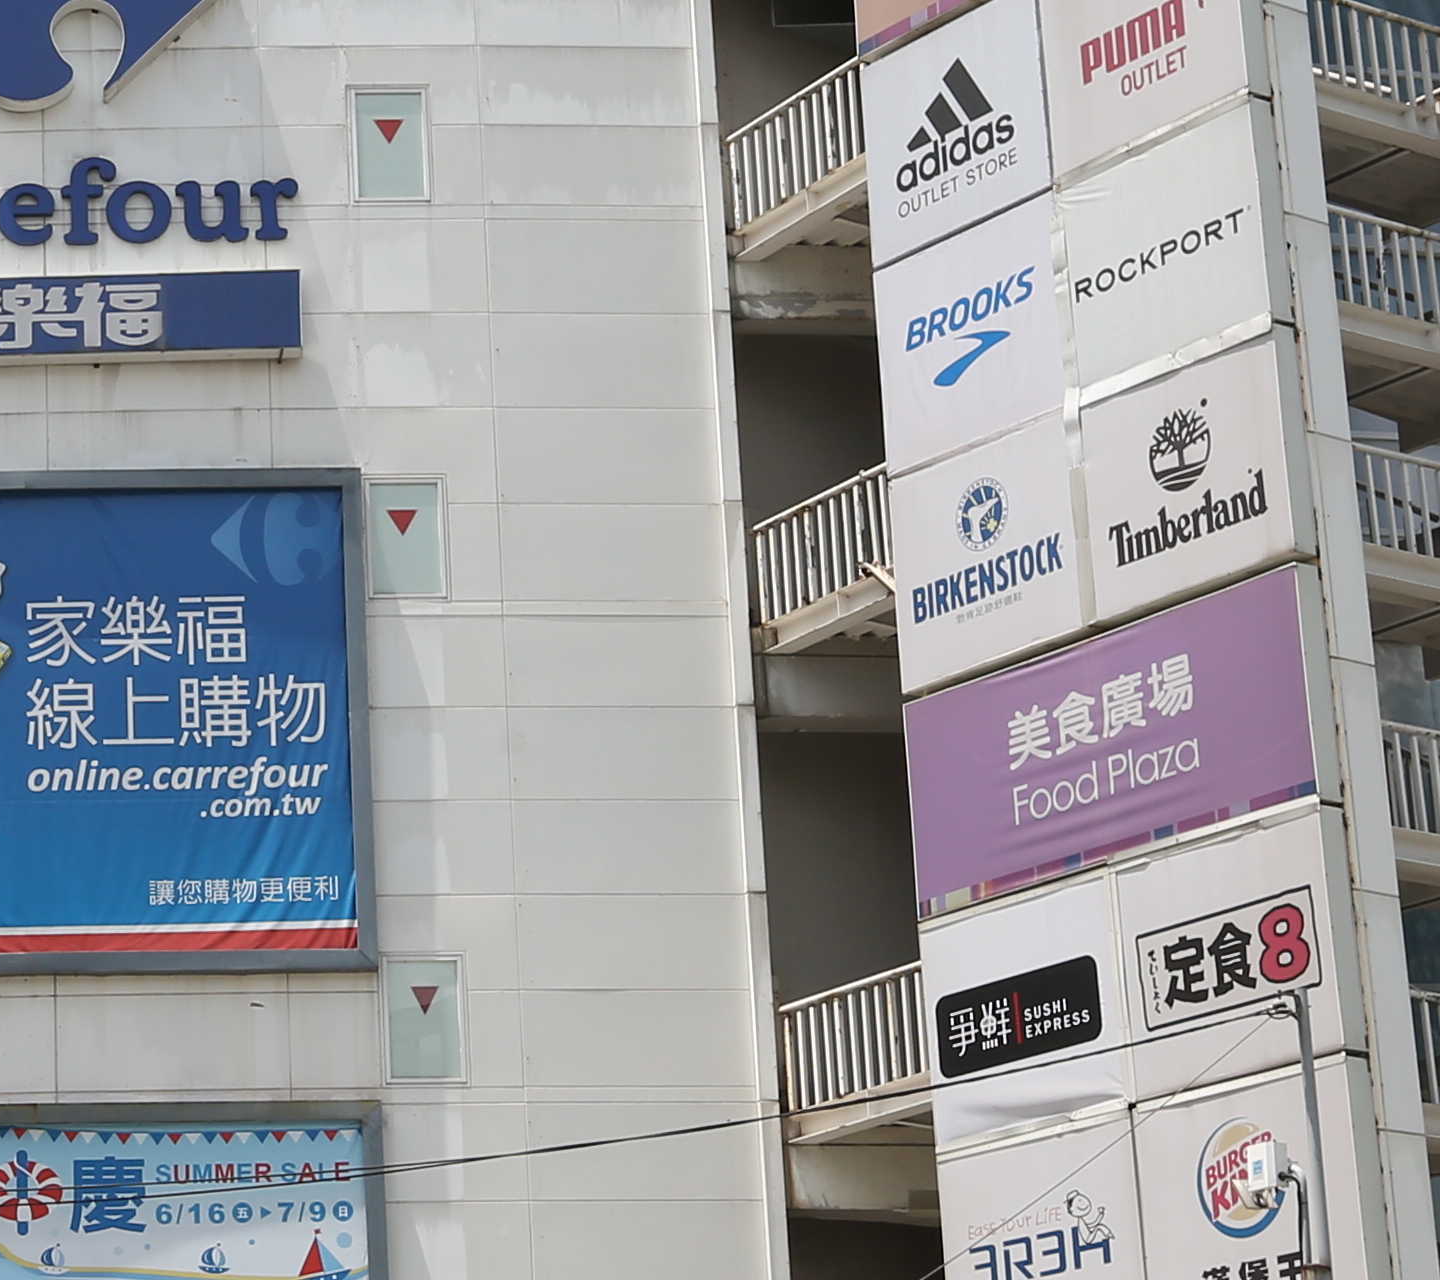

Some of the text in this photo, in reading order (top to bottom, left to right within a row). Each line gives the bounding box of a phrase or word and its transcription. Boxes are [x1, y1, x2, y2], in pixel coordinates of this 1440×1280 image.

[1120, 45, 1187, 97] OUTLET
[896, 113, 1016, 193] adidas
[898, 147, 1019, 219] OUTLET STORE
[1075, 208, 1243, 303] ROCKPORT
[905, 265, 1035, 352] BROOKS
[1109, 468, 1268, 568] Timberland
[912, 532, 1064, 624] BIRKENSTOCK
[24, 594, 247, 667] 家樂福
[25, 674, 328, 751] 線上購物
[1007, 653, 1195, 771] 美食廣場
[27, 758, 328, 795] online.carrefour
[199, 791, 321, 819] .com.tw
[1012, 737, 1201, 826] Food Plaza
[148, 874, 340, 907] 讓您購物更便利
[948, 997, 1012, 1057] 爭鮮
[1024, 998, 1068, 1021] SUSHI
[1025, 1009, 1091, 1038] EXPRESS
[156, 1162, 272, 1183] SUMMER
[281, 1162, 351, 1182] SALE
[155, 1201, 326, 1225] 6/16 7/9
